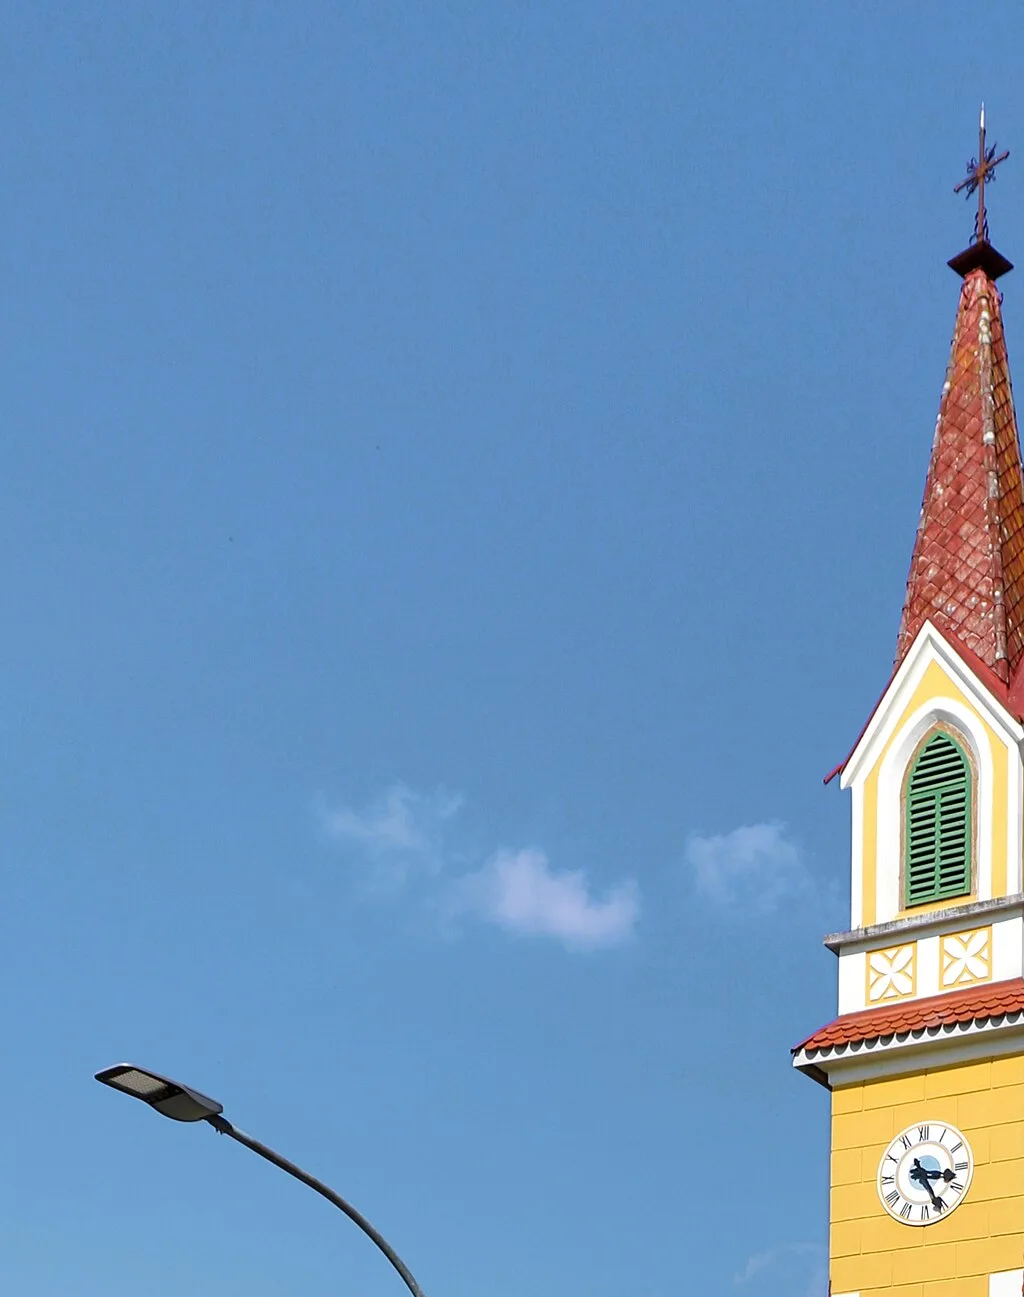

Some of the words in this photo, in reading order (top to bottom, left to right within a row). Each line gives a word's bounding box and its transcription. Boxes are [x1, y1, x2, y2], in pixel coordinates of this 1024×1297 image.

[918, 1126, 929, 1142] XII
[899, 1135, 912, 1150] XI
[950, 1141, 963, 1153] II
[955, 1161, 968, 1171] III
[881, 1174, 894, 1185] IX
